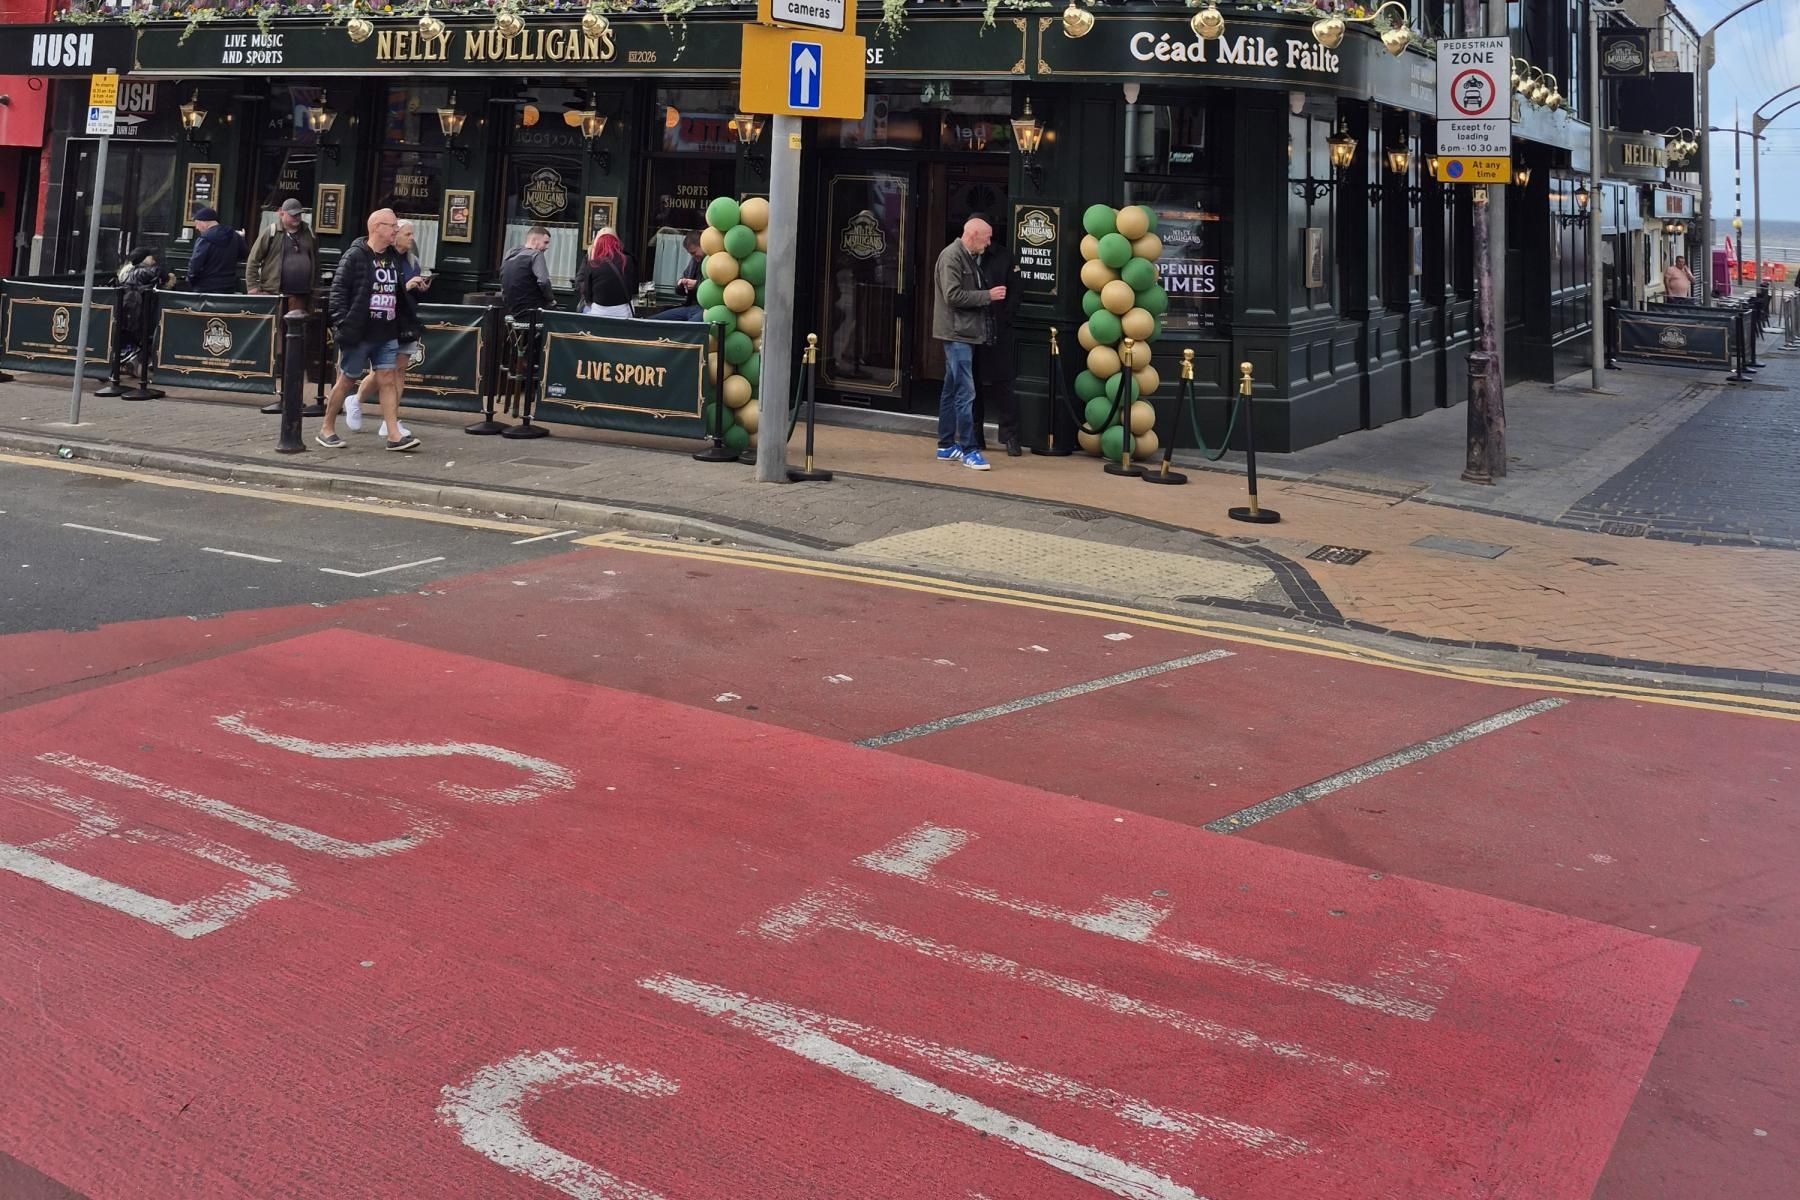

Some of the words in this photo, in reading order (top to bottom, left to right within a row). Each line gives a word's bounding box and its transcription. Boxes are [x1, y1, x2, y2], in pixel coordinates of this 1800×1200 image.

[788, 2, 830, 19] cameras
[225, 34, 247, 47] LIVE
[251, 34, 284, 48] MUSIC
[376, 30, 454, 62] NELLY
[464, 28, 616, 62] MULLIGANS
[1443, 41, 1503, 50] PEDESTRIAN
[31, 33, 94, 67] HUSH
[1130, 31, 1206, 63] Céad
[222, 50, 243, 64] AND
[246, 50, 283, 64] SPORTS
[1451, 52, 1494, 64] ZONE
[117, 83, 155, 112] USH
[1451, 123, 1480, 133] Except
[1483, 123, 1496, 132] for
[1457, 131, 1489, 141] loading
[1440, 144, 1446, 152] 6
[1447, 146, 1460, 154] pm
[1467, 144, 1492, 153] 10.30
[1472, 161, 1483, 169] At
[1485, 162, 1501, 171] any
[283, 169, 298, 179] LIVE
[395, 174, 429, 185] WHISKEY
[1477, 170, 1496, 178] time
[279, 180, 300, 190] MUSIC
[676, 185, 709, 196] SPORTS
[411, 187, 429, 197] ALES
[664, 198, 697, 209] SHOWN
[1021, 247, 1052, 257] WHISKEY
[1020, 256, 1034, 264] AND
[1036, 257, 1052, 266] ALES
[1020, 271, 1031, 279] IVE
[1034, 272, 1055, 280] MUSIC
[1160, 277, 1216, 293] IMES
[576, 359, 612, 381] LIVE
[615, 363, 667, 387] SPORT
